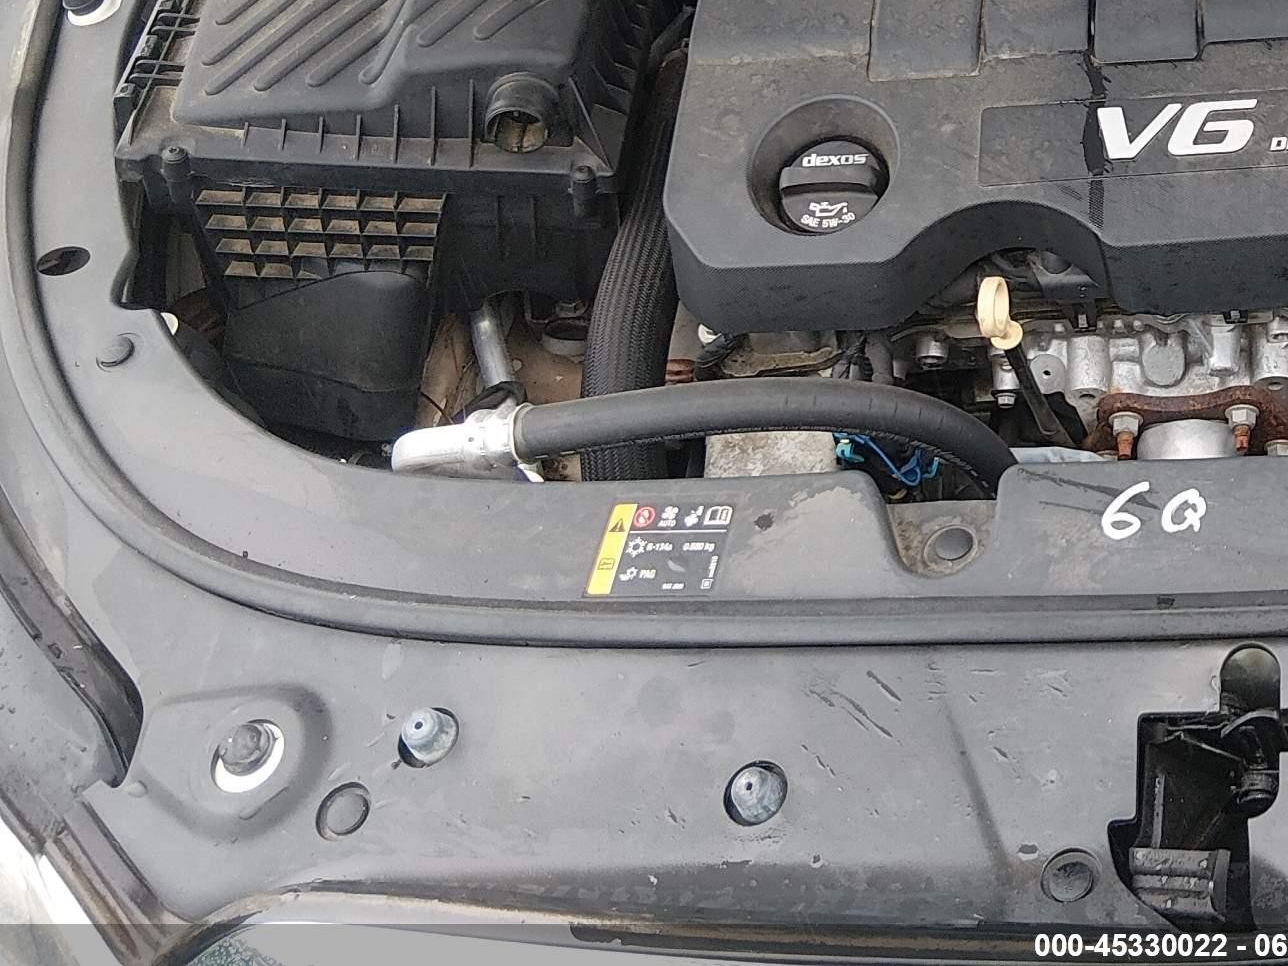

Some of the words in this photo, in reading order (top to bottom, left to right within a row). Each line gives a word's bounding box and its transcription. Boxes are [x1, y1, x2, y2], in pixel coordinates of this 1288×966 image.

[1097, 98, 1258, 159] V6
[802, 153, 869, 167] dexos
[801, 214, 820, 228] SAE
[821, 213, 856, 228] 5W-30
[657, 519, 677, 527] AUTO
